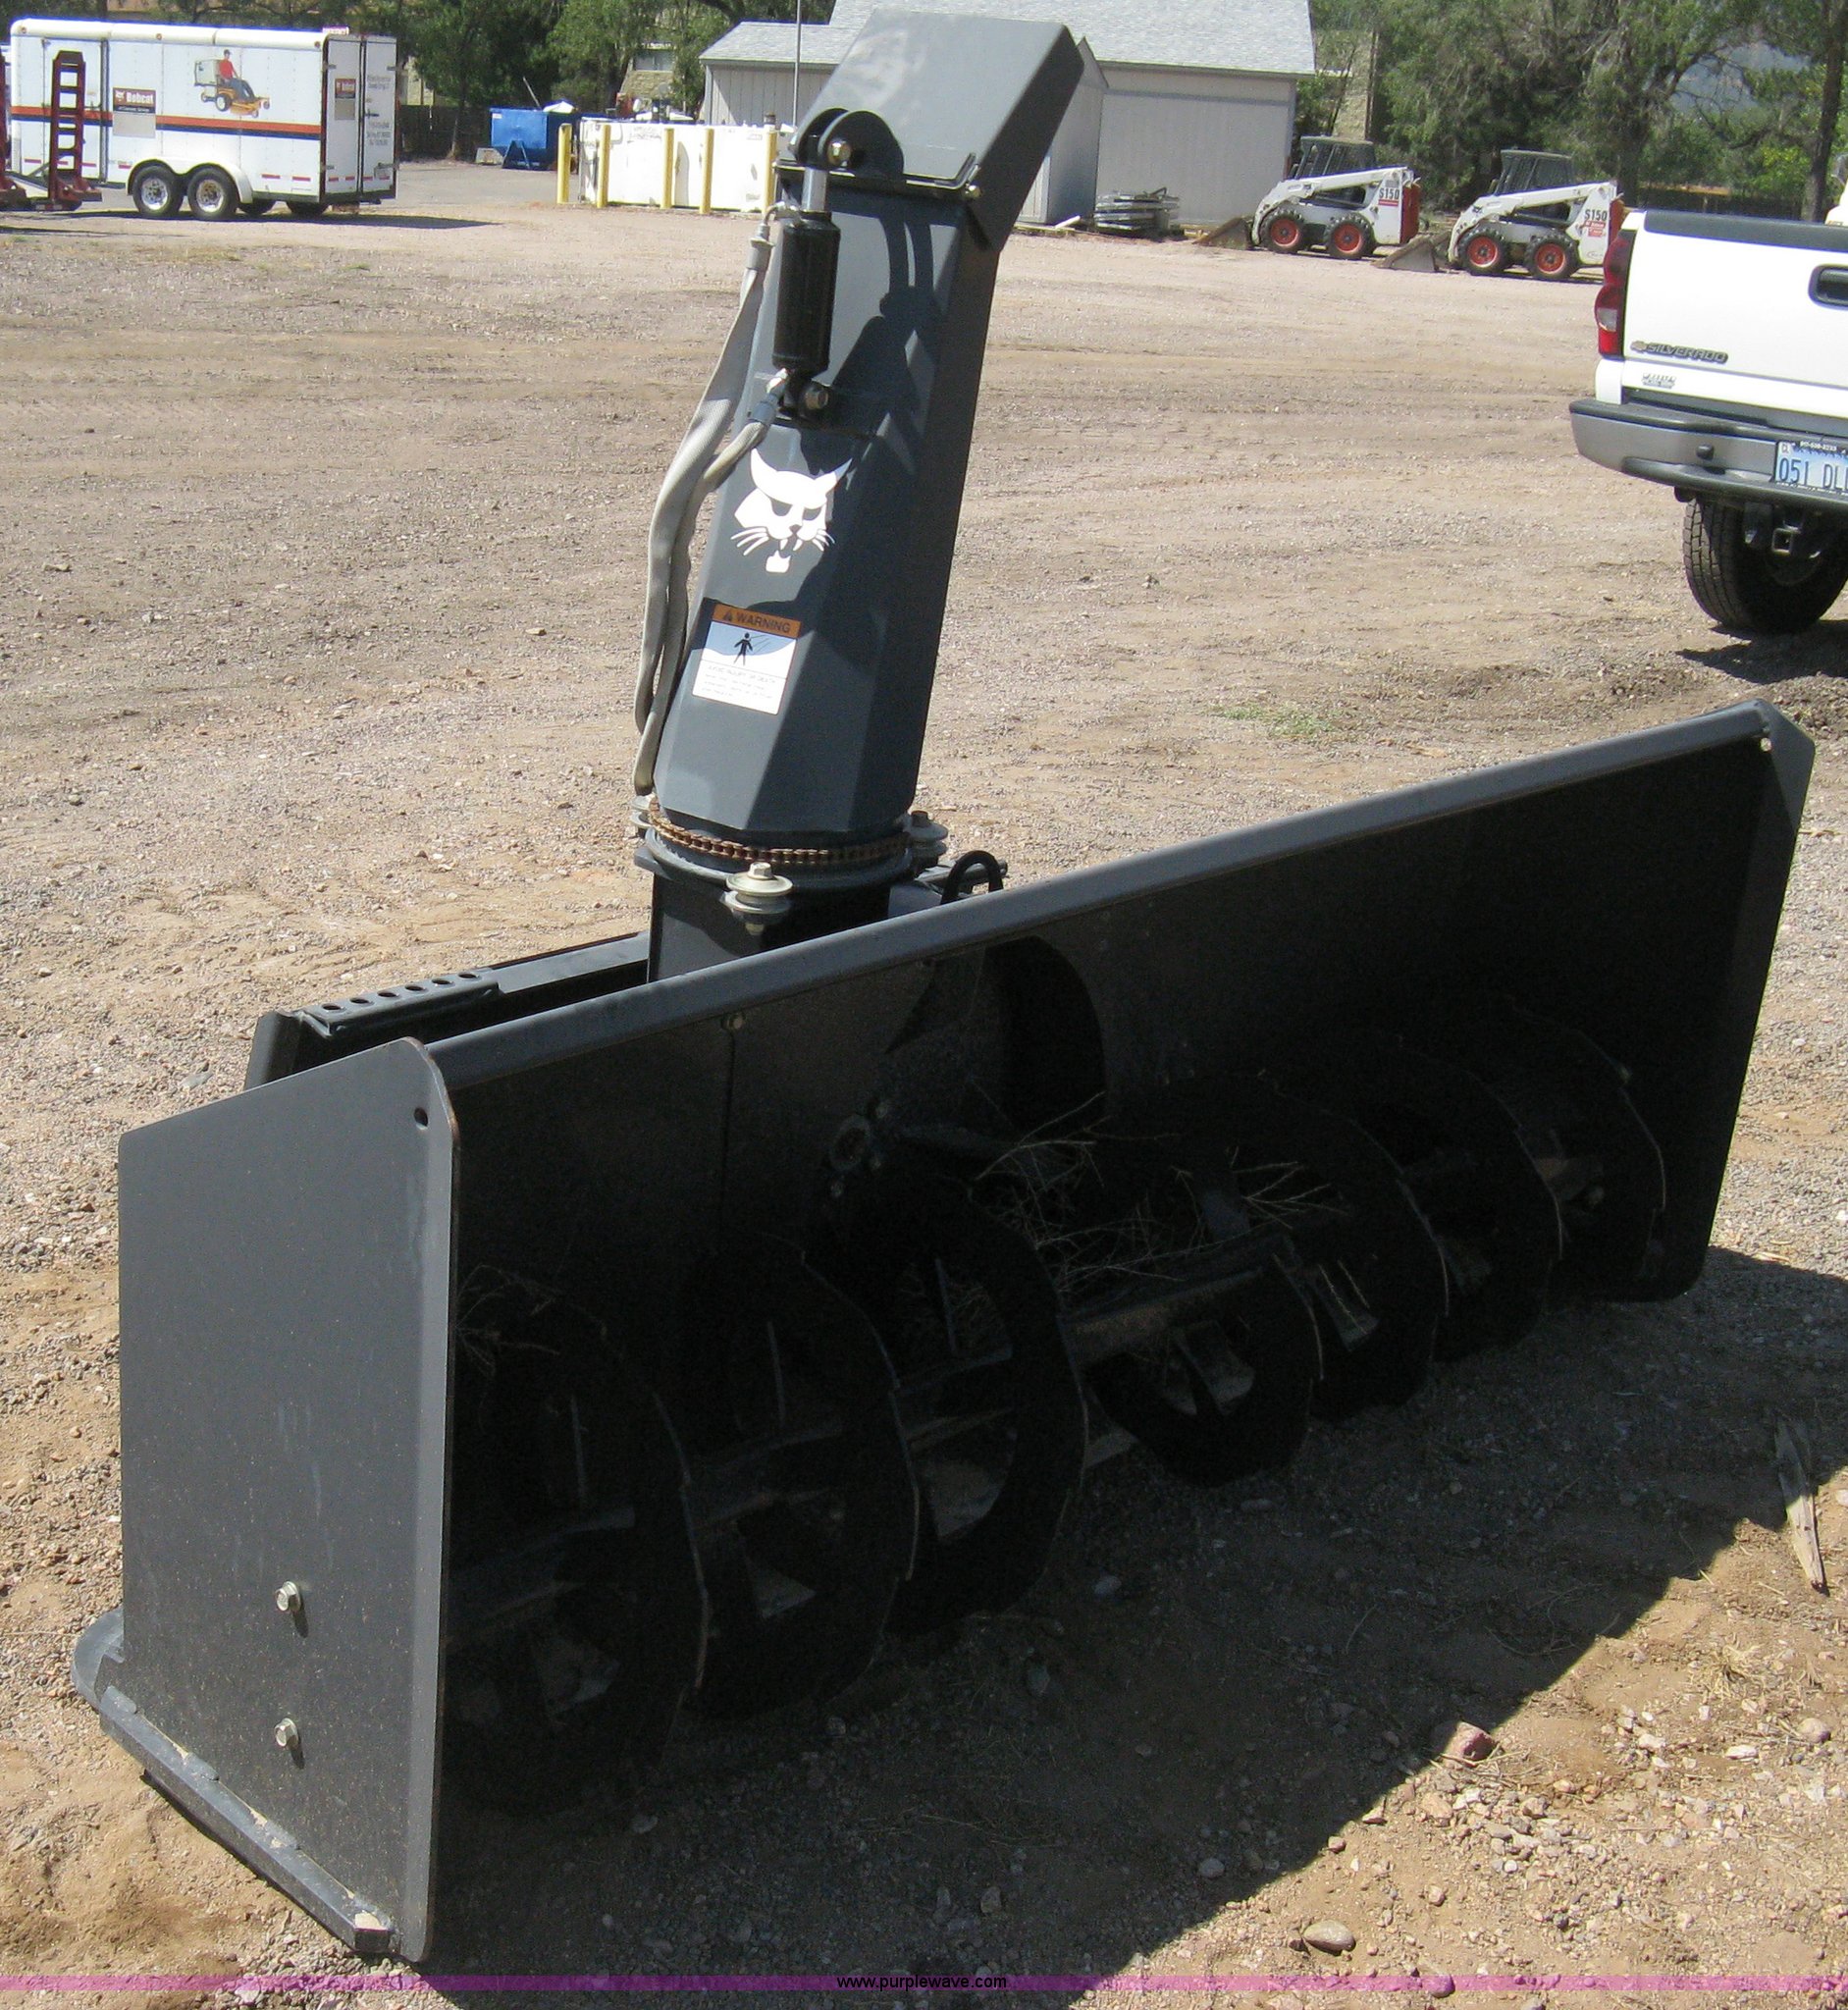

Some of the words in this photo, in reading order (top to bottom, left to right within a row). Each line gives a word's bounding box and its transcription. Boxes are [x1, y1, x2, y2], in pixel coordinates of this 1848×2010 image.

[126, 91, 154, 105] Bobcat
[1379, 187, 1400, 200] S150
[1585, 209, 1608, 221] S150
[1648, 343, 1727, 364] SILVERADO
[1778, 457, 1810, 487] 051
[736, 611, 791, 633] WARNING
